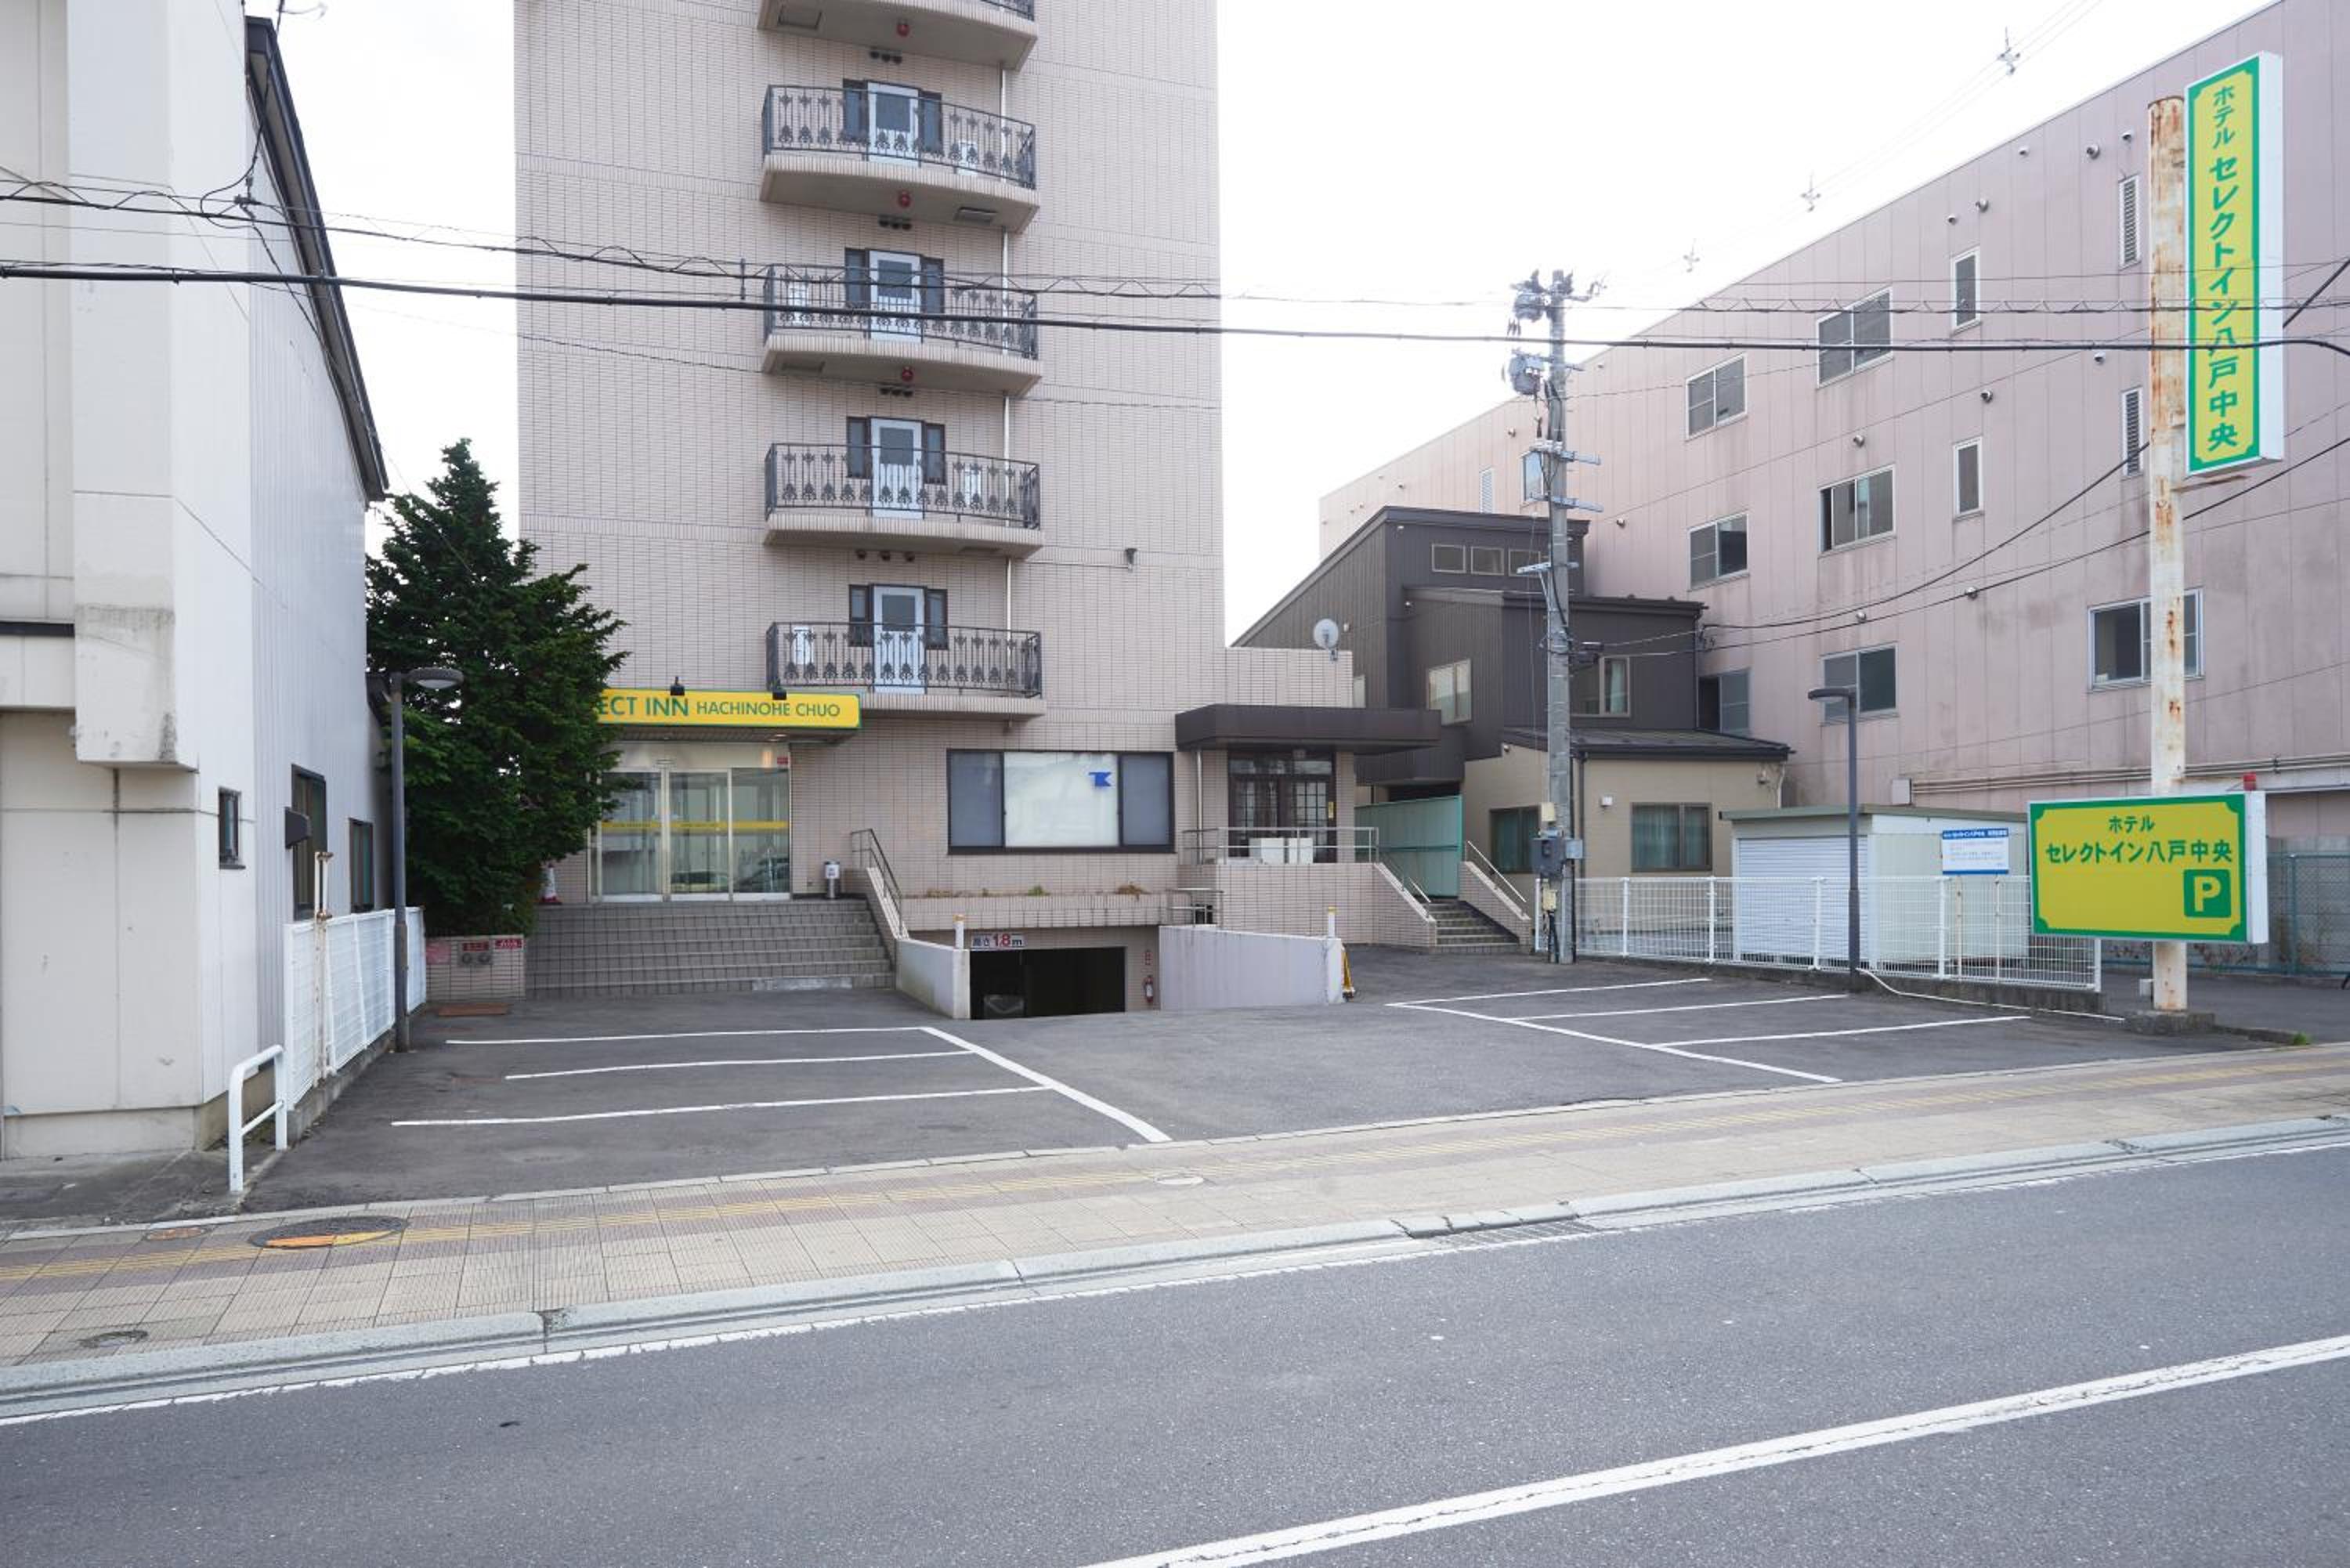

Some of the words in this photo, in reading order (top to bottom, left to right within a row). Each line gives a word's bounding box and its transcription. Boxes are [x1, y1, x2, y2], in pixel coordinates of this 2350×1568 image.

[597, 695, 638, 715] ECT
[645, 696, 689, 716] INN
[696, 701, 790, 717] HACHINOHE
[796, 703, 841, 717] CHUO
[2109, 815, 2155, 834] ホテル
[2045, 839, 2232, 864] セレクトイン八戸中央
[2194, 876, 2222, 912] P
